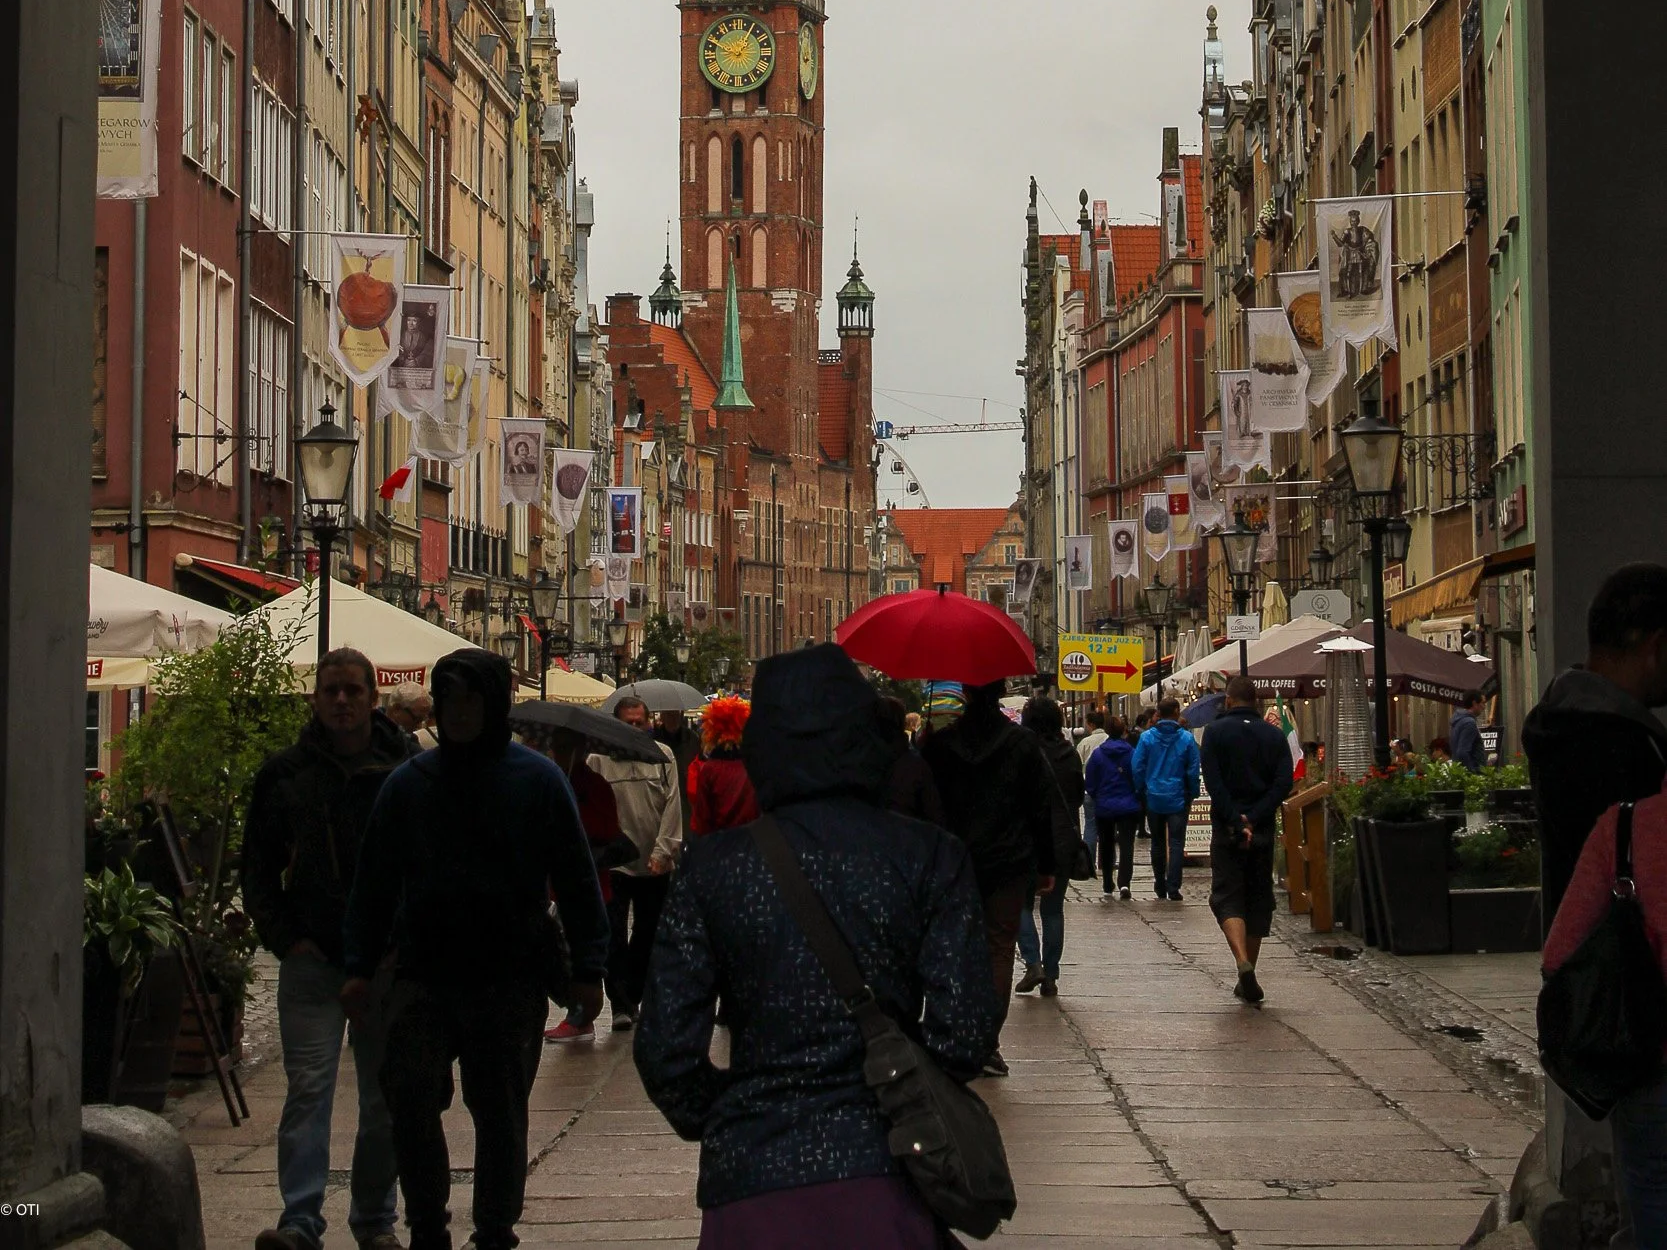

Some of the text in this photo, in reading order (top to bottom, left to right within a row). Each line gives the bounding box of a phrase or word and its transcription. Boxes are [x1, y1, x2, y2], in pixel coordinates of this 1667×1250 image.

[1088, 643, 1117, 654] 12 zł
[379, 670, 422, 683] TYSKIE
[1271, 679, 1296, 688] COFFEE
[1410, 682, 1463, 701] COSTA COFFE
